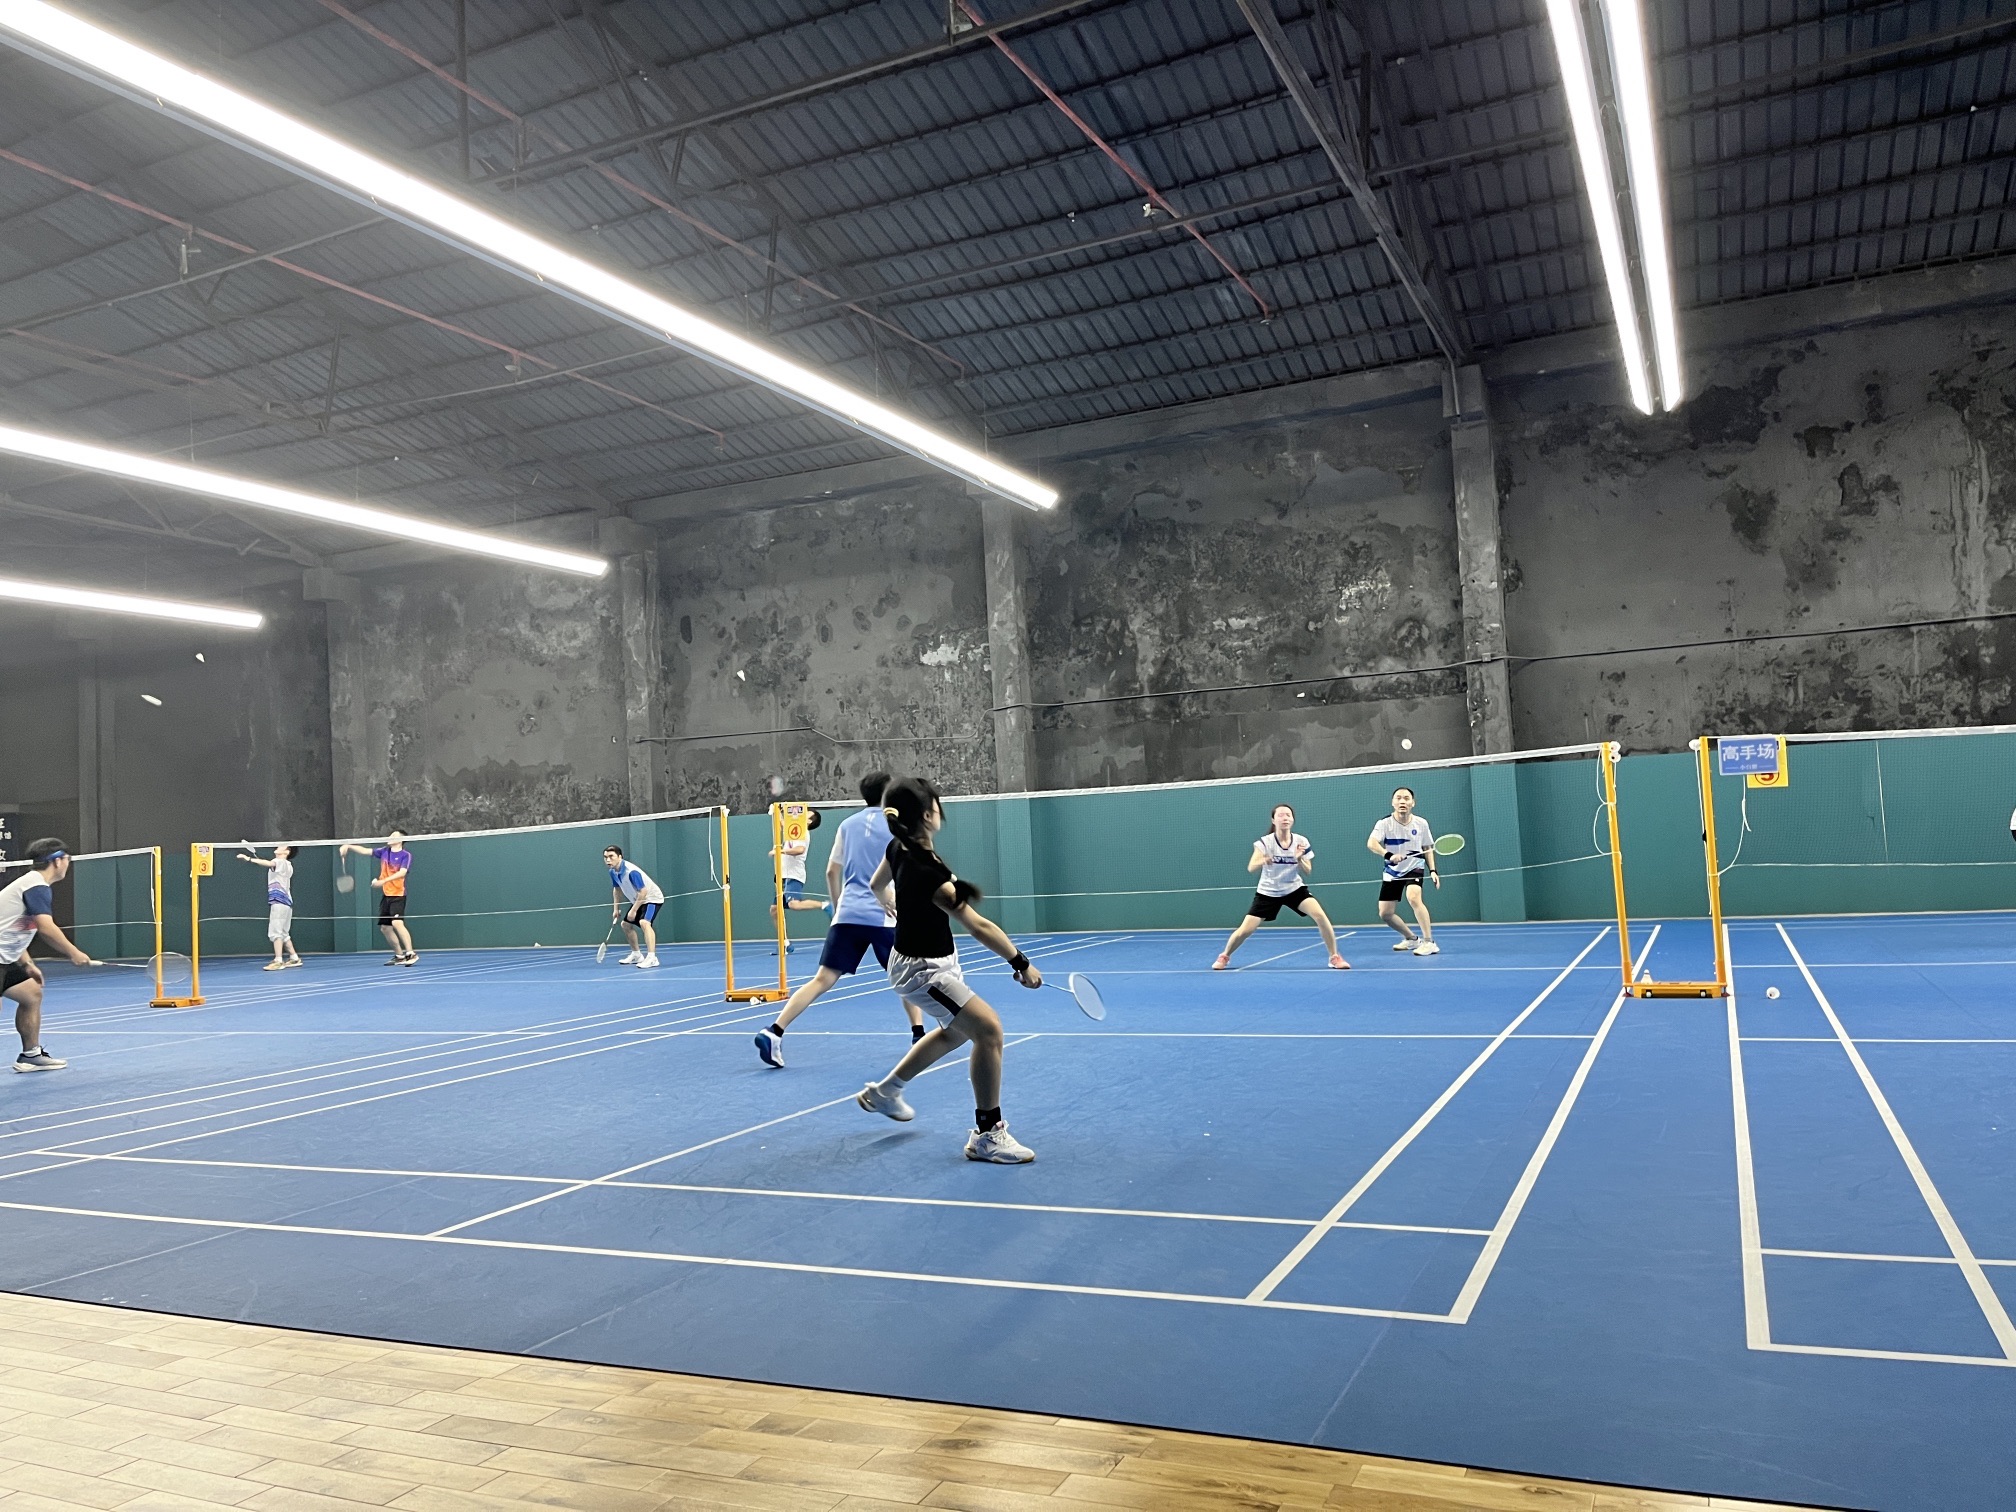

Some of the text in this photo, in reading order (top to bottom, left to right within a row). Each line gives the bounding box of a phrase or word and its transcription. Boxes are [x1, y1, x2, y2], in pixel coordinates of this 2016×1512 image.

[1722, 743, 1775, 761] 高手场
[790, 826, 799, 837] 4
[201, 862, 207, 872] 3
